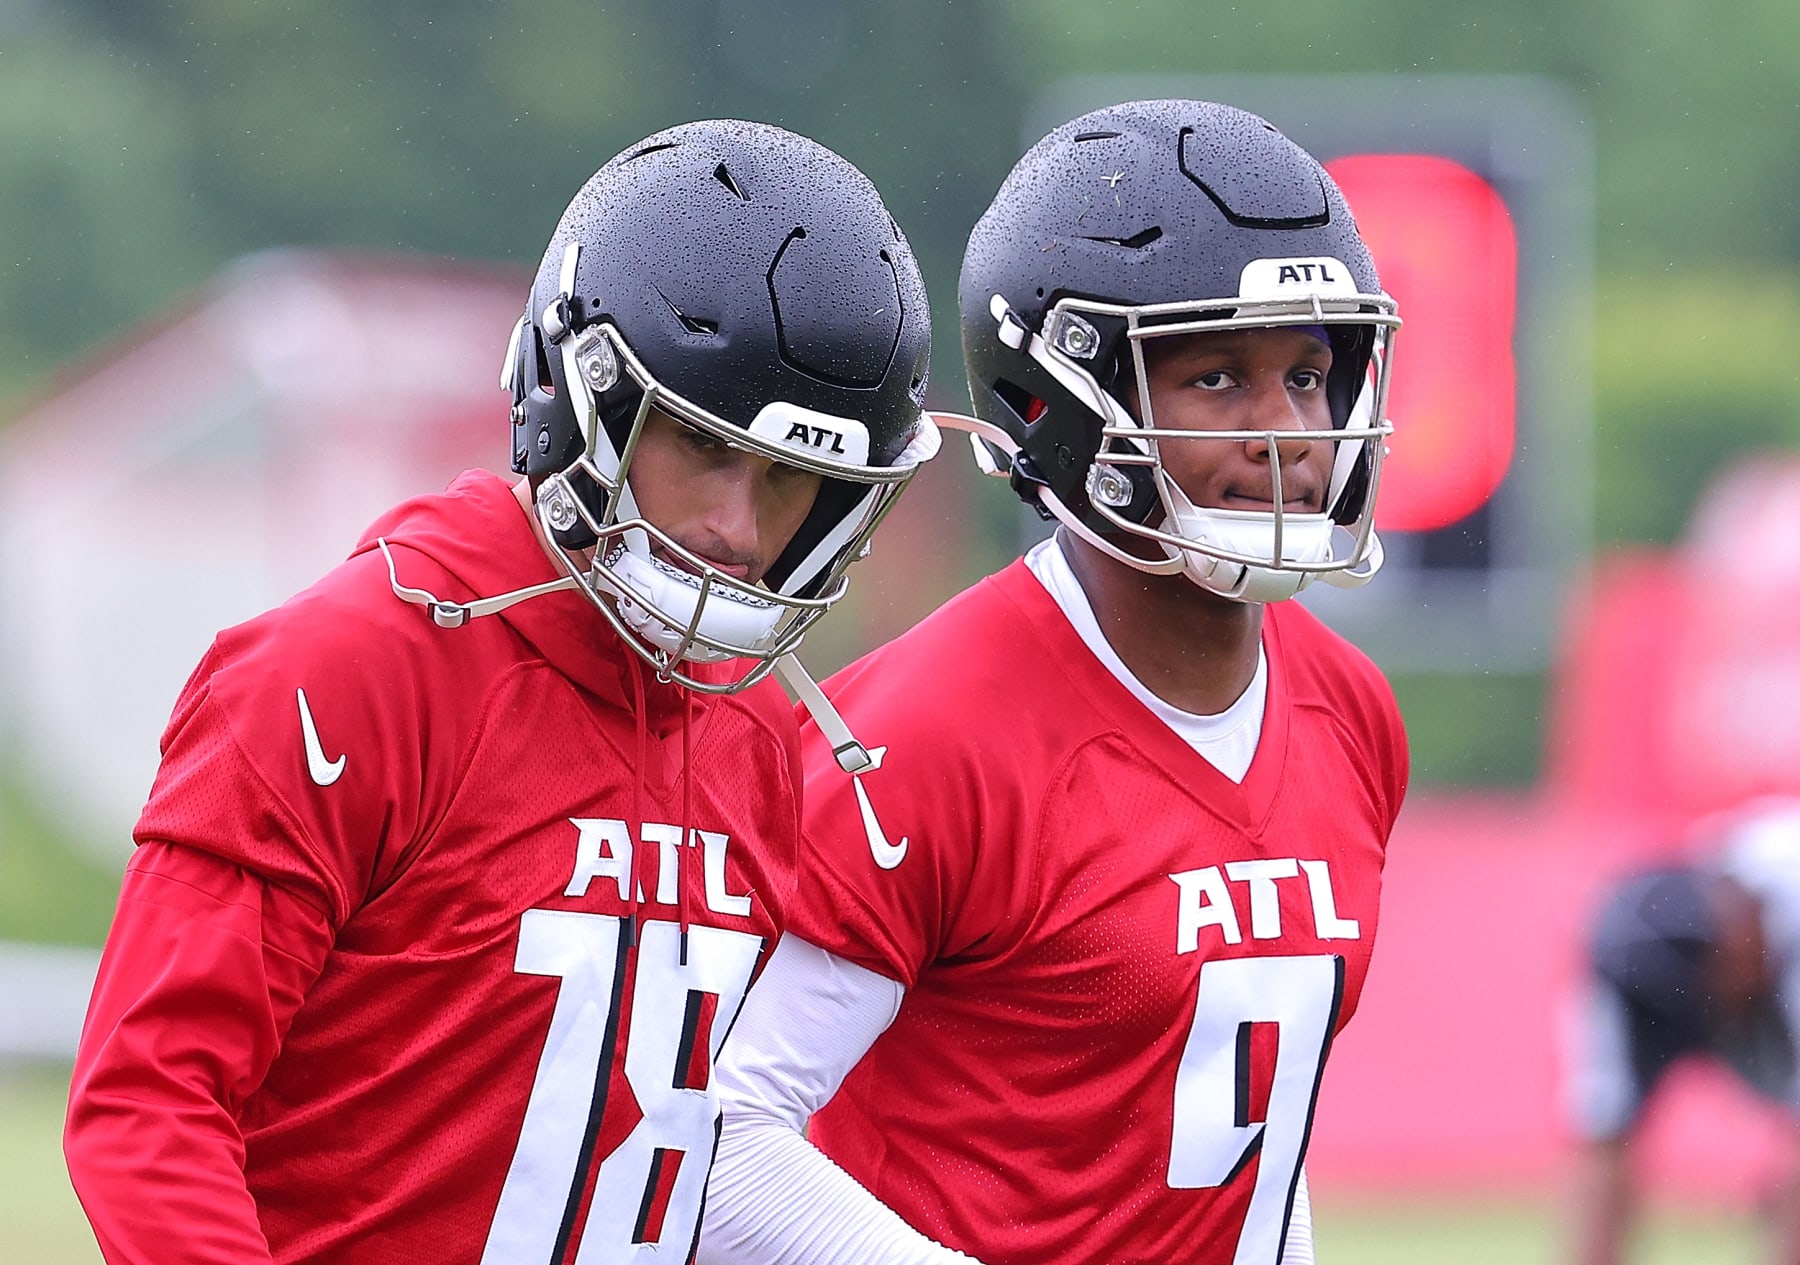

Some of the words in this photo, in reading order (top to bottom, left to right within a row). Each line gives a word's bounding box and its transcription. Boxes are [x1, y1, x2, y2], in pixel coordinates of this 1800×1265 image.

[1279, 264, 1335, 284] ATL
[785, 422, 845, 454] ATL
[563, 817, 753, 916] ATL
[1168, 857, 1361, 955] ATL
[478, 908, 767, 1265] 18
[1166, 954, 1346, 1265] 9
